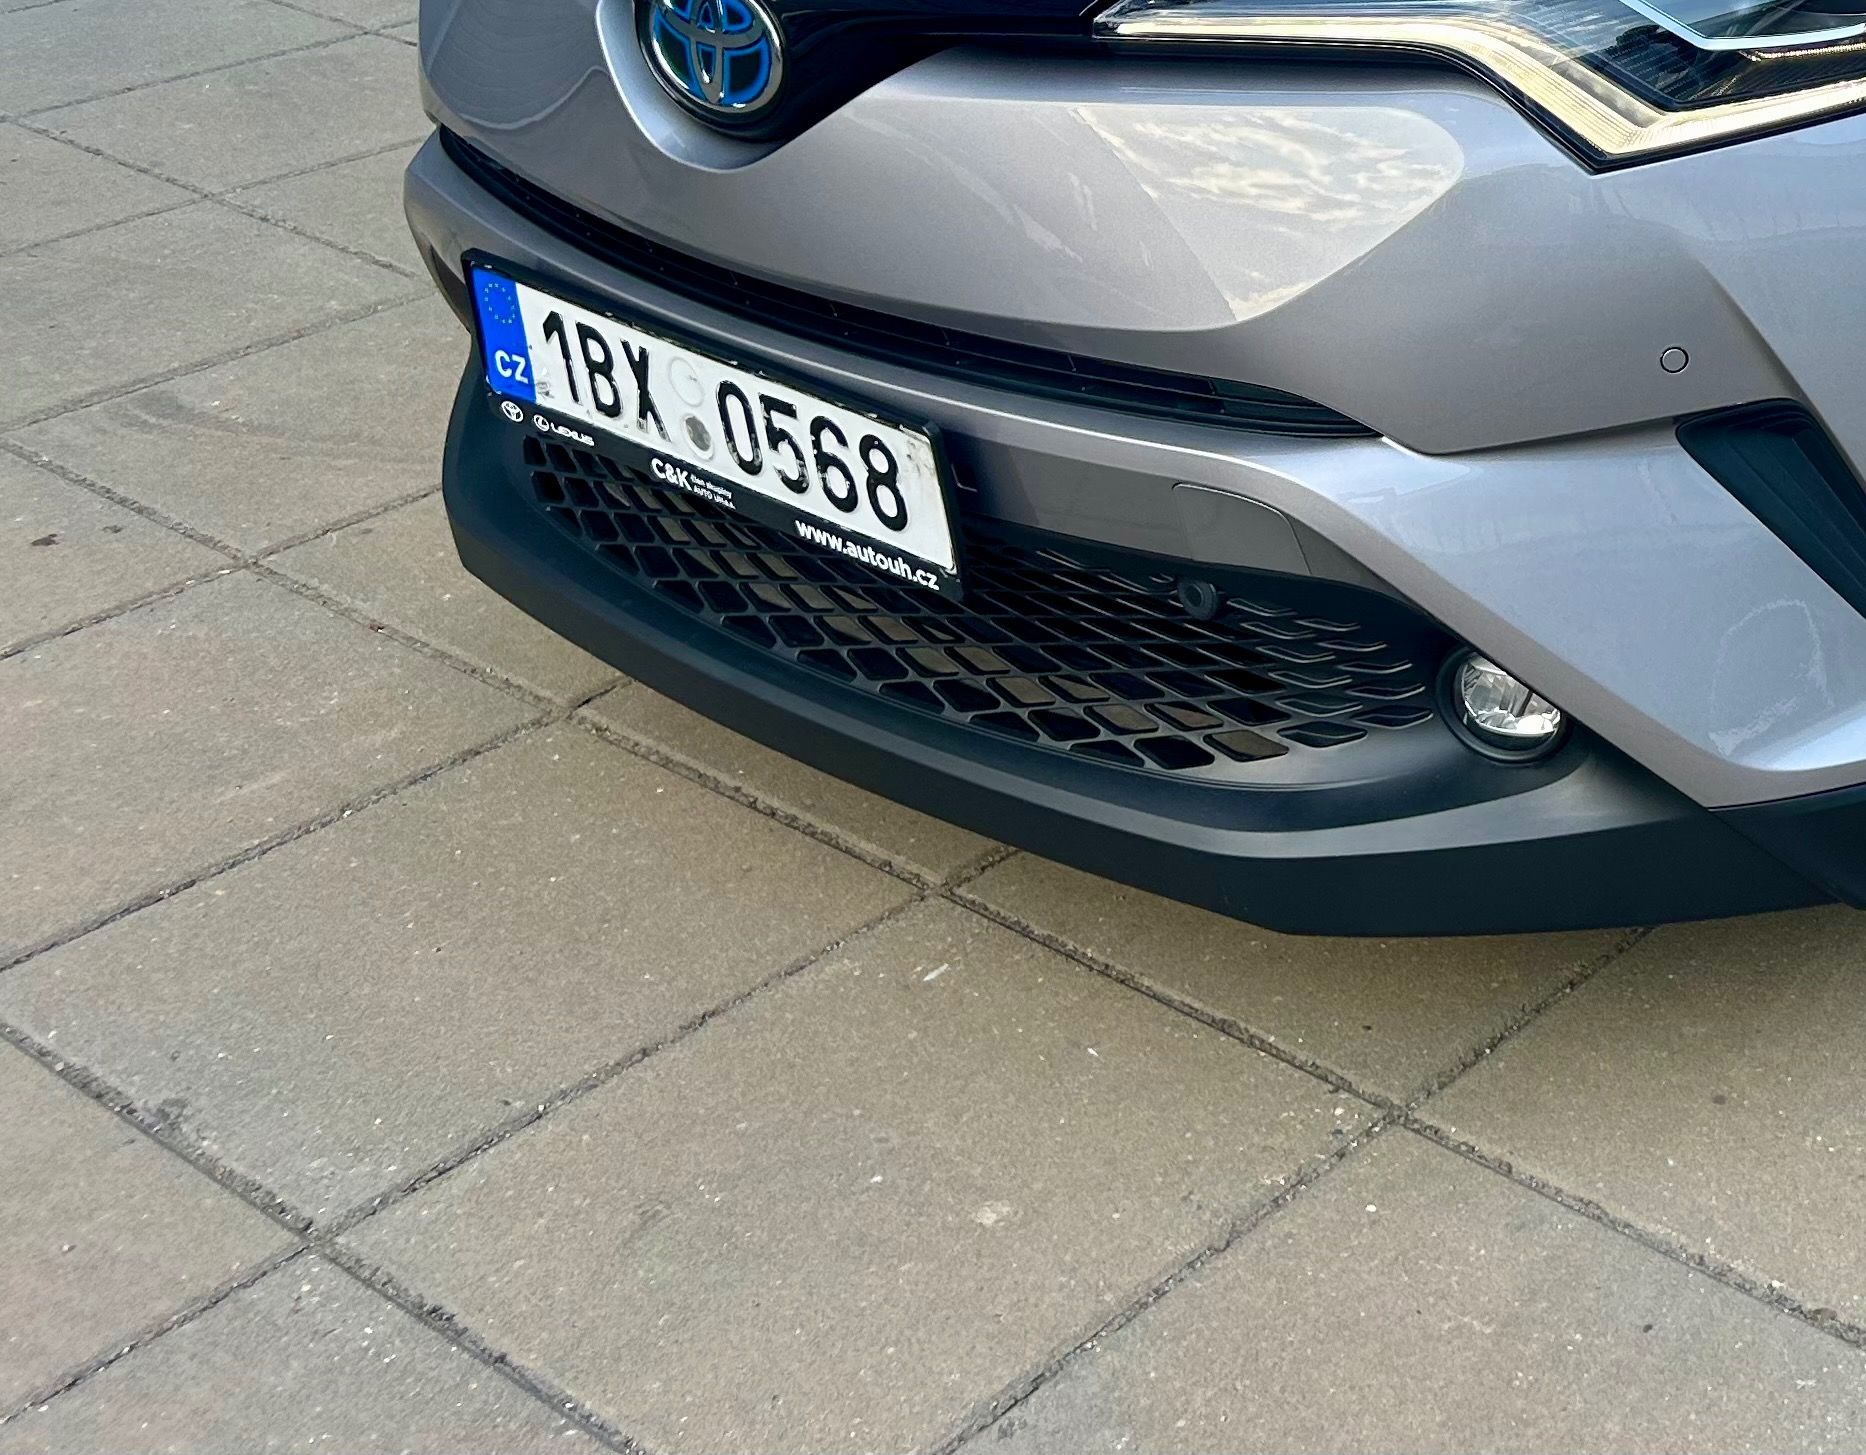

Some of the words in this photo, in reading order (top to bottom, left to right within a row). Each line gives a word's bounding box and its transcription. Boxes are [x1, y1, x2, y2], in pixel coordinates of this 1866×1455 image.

[494, 348, 529, 385] CZ
[541, 310, 670, 443] 1BX
[714, 379, 909, 533] 0568
[651, 458, 692, 491] C&K
[794, 519, 940, 591] www.autouh.cz
